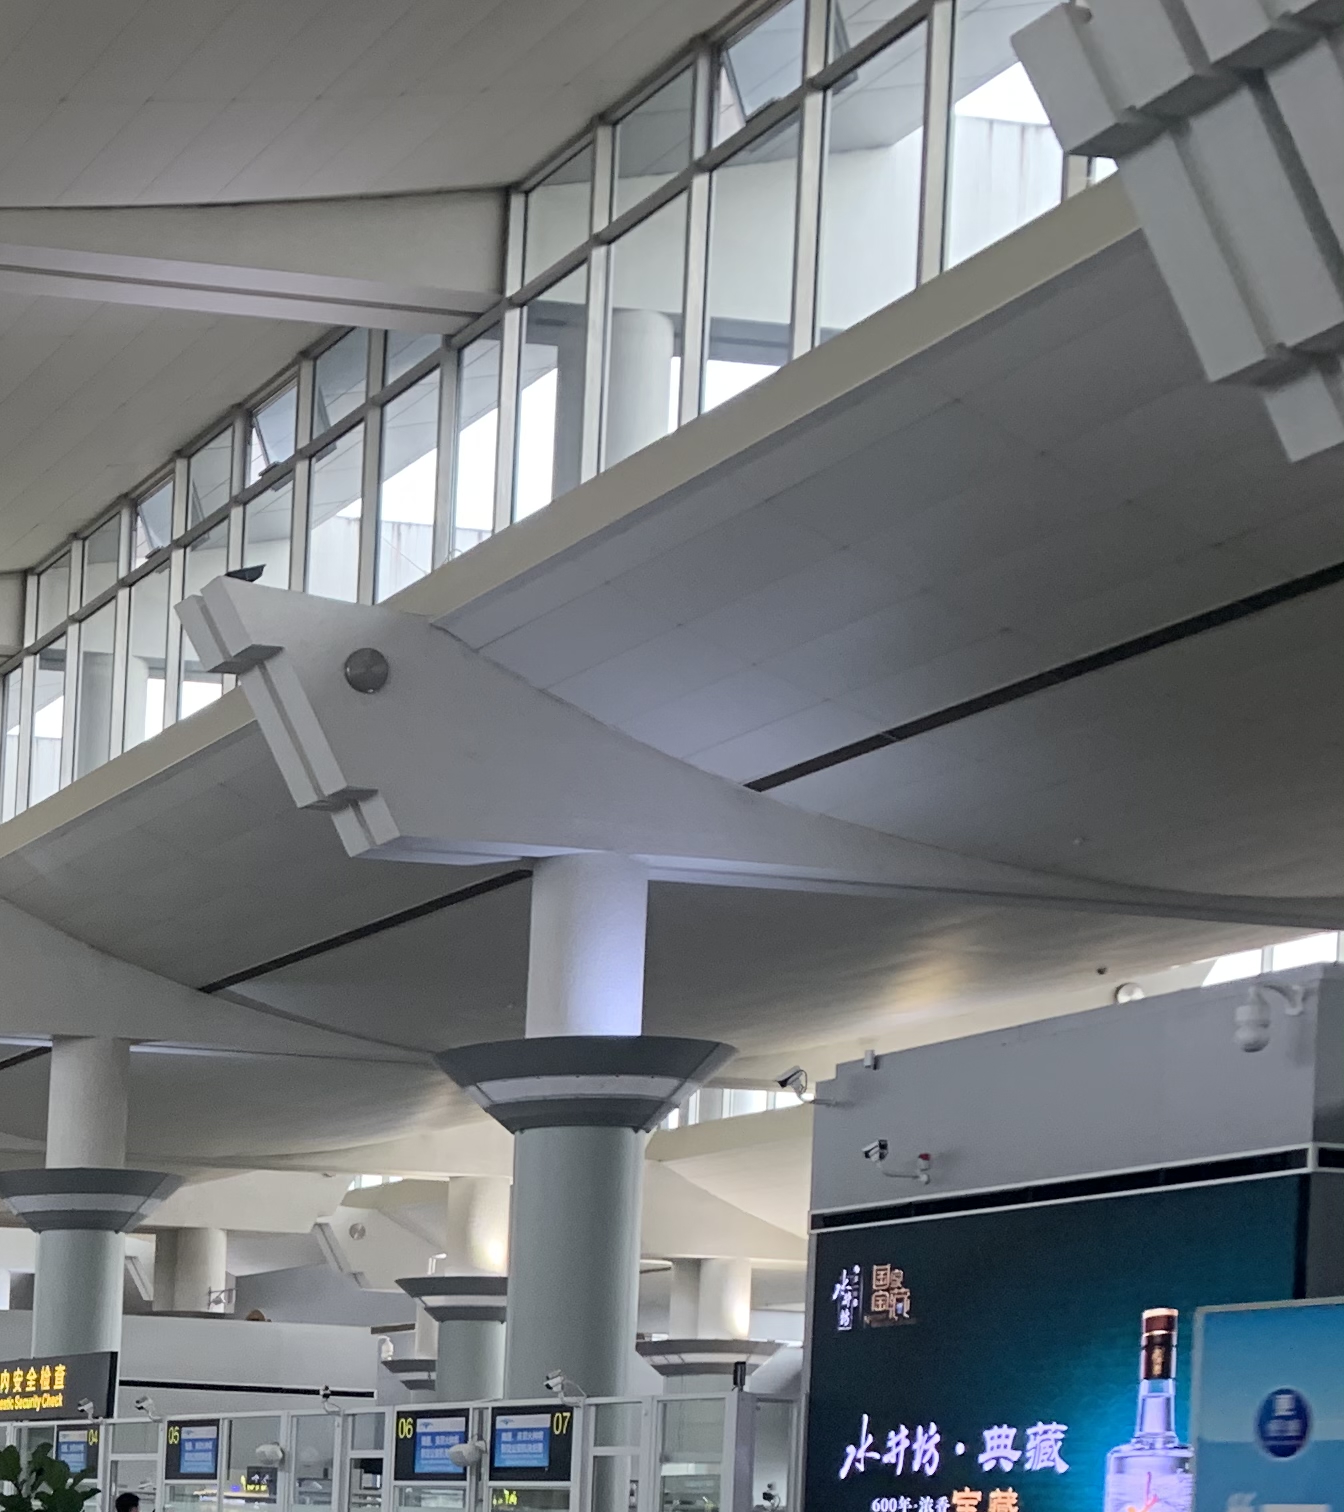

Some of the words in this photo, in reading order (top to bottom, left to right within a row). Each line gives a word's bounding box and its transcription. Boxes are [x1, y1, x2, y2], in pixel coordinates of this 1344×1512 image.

[14, 1394, 42, 1412] Security
[42, 1392, 63, 1409] Check
[398, 1418, 413, 1439] 06
[553, 1412, 571, 1435] 07
[88, 1428, 98, 1446] 04
[168, 1425, 180, 1445] 05
[838, 1413, 1070, 1480] 水井坊·典藏
